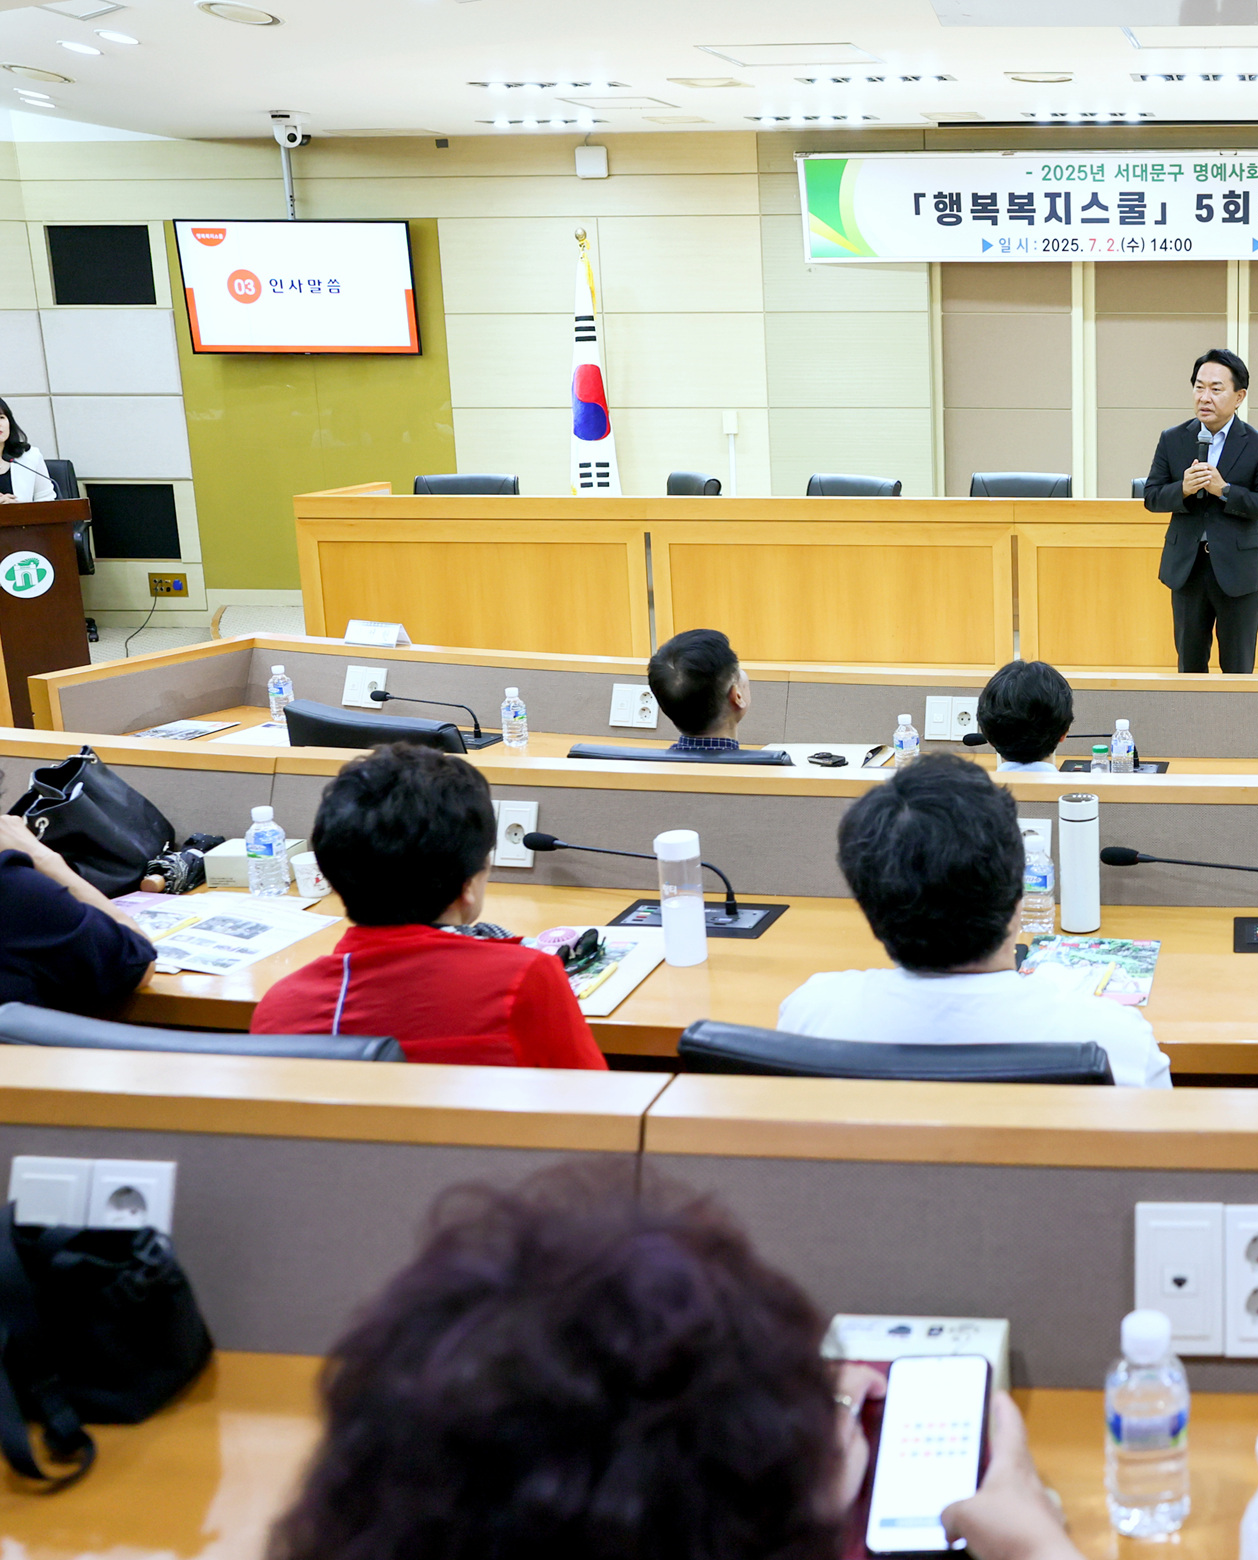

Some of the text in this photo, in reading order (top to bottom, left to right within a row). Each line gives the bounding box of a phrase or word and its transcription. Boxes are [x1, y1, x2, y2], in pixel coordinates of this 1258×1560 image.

[1041, 163, 1105, 183] 2025년
[1114, 162, 1185, 183] 서대문구
[914, 191, 1167, 226] 「행복복지스쿨」
[1150, 238, 1193, 252] 14:00
[234, 278, 256, 296] 03
